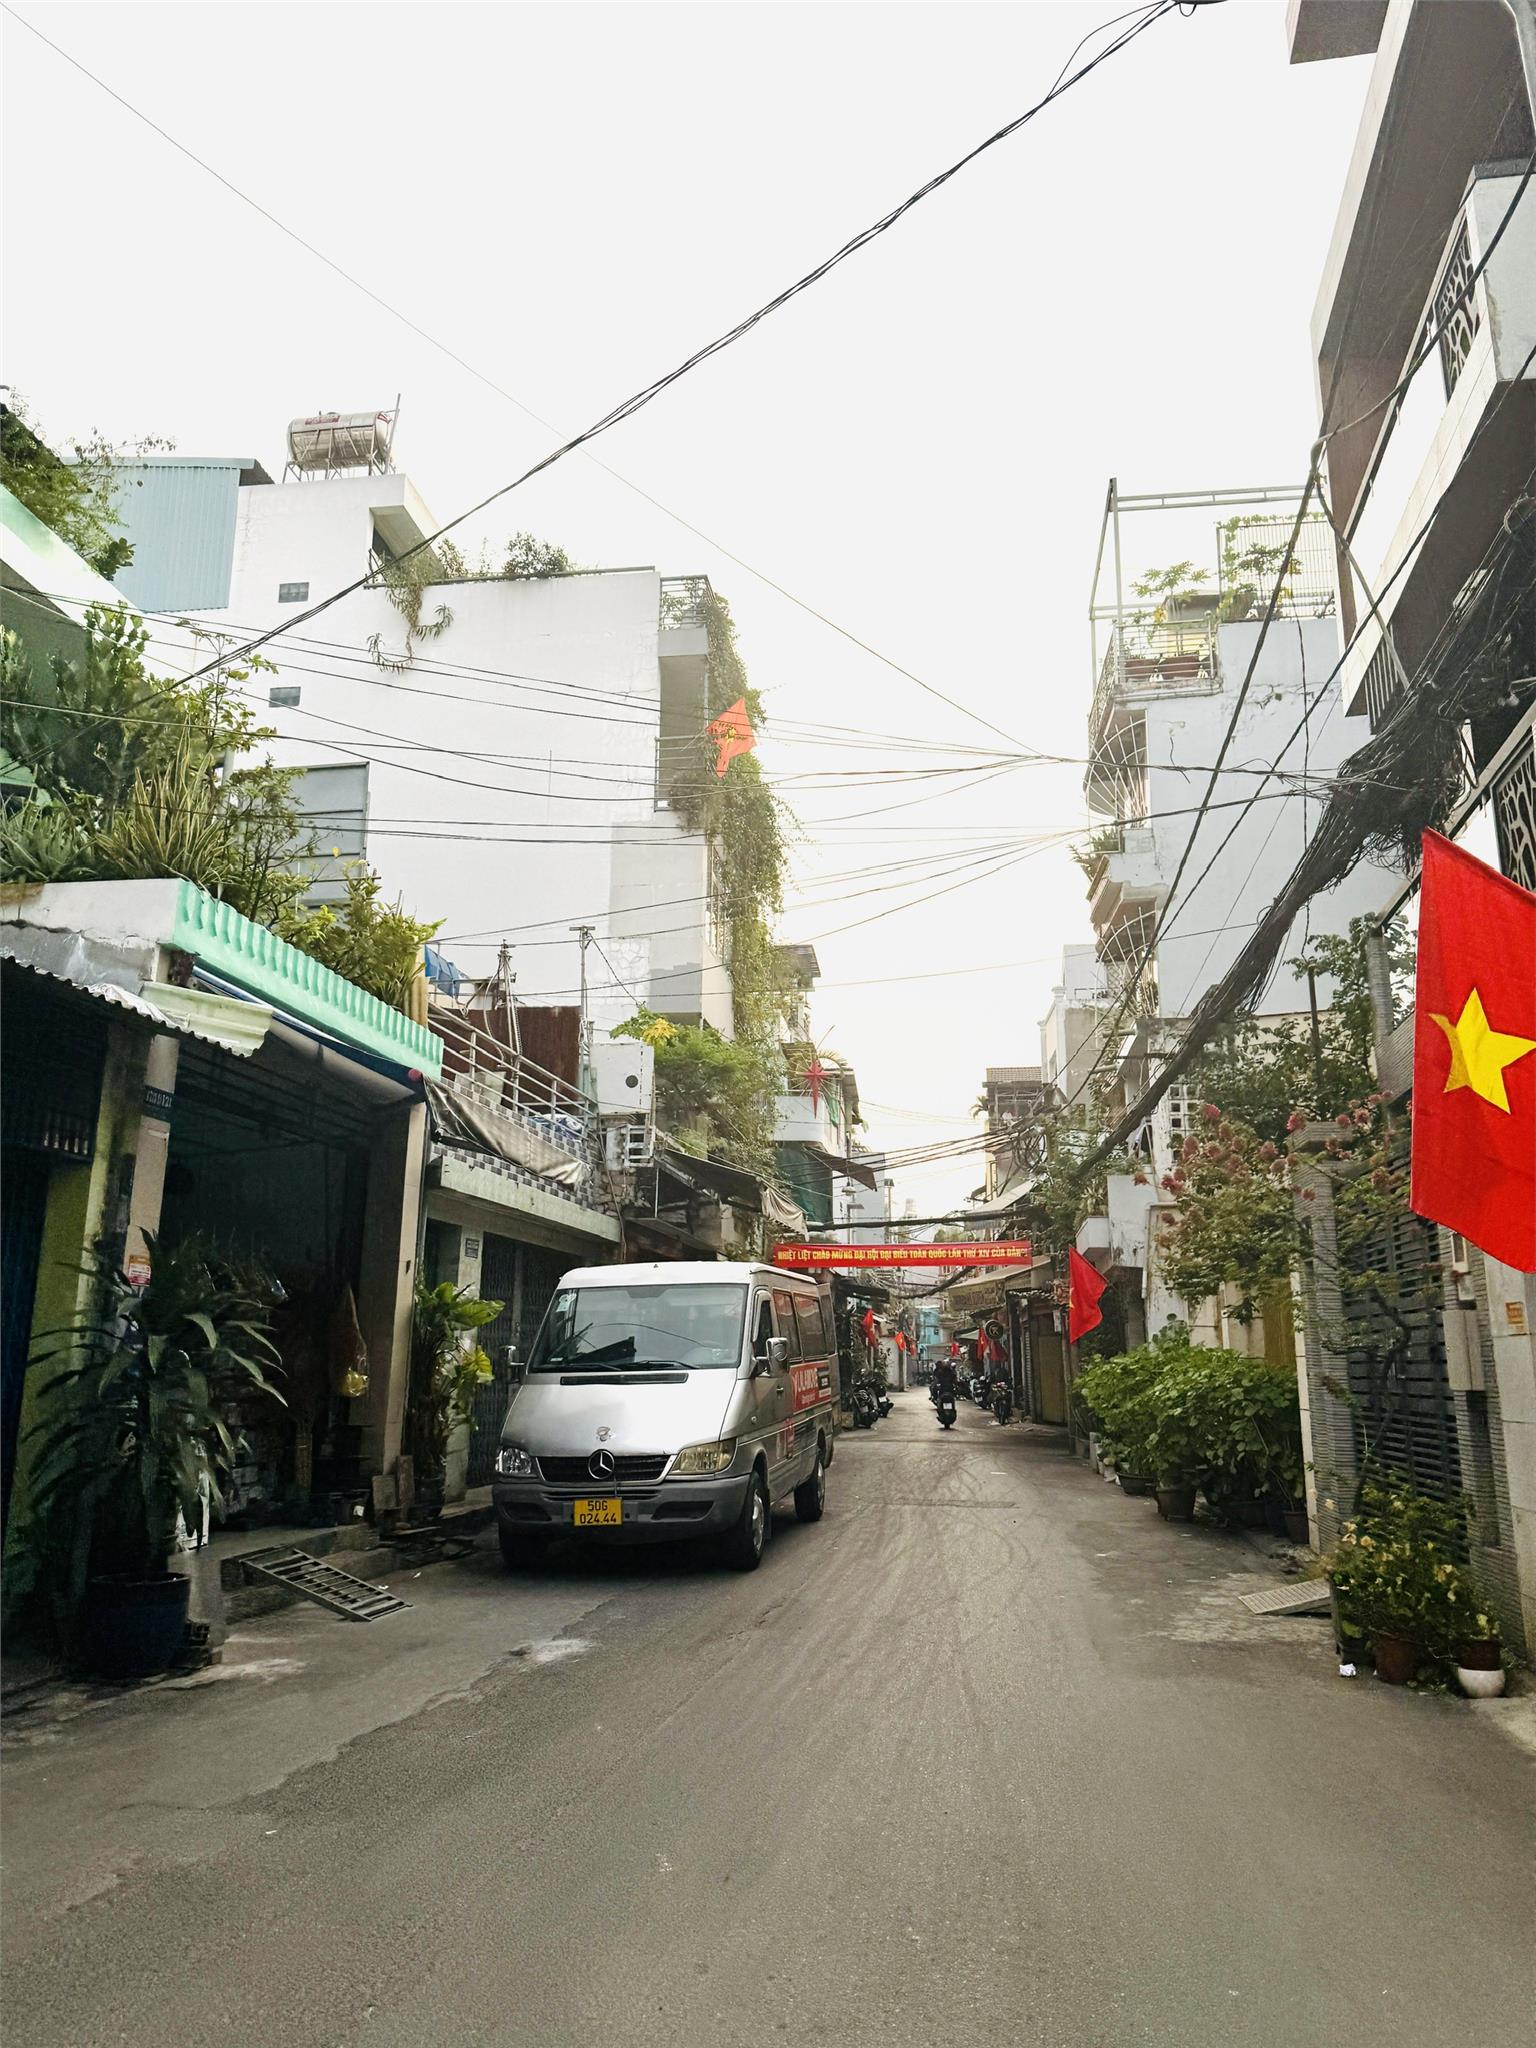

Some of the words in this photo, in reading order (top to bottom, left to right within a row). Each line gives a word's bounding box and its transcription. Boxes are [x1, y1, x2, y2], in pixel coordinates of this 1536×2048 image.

[798, 1249, 811, 1261] LIỆT
[928, 1248, 946, 1259] QUỐC
[587, 1500, 608, 1511] 50G
[579, 1513, 617, 1524] 024.44
